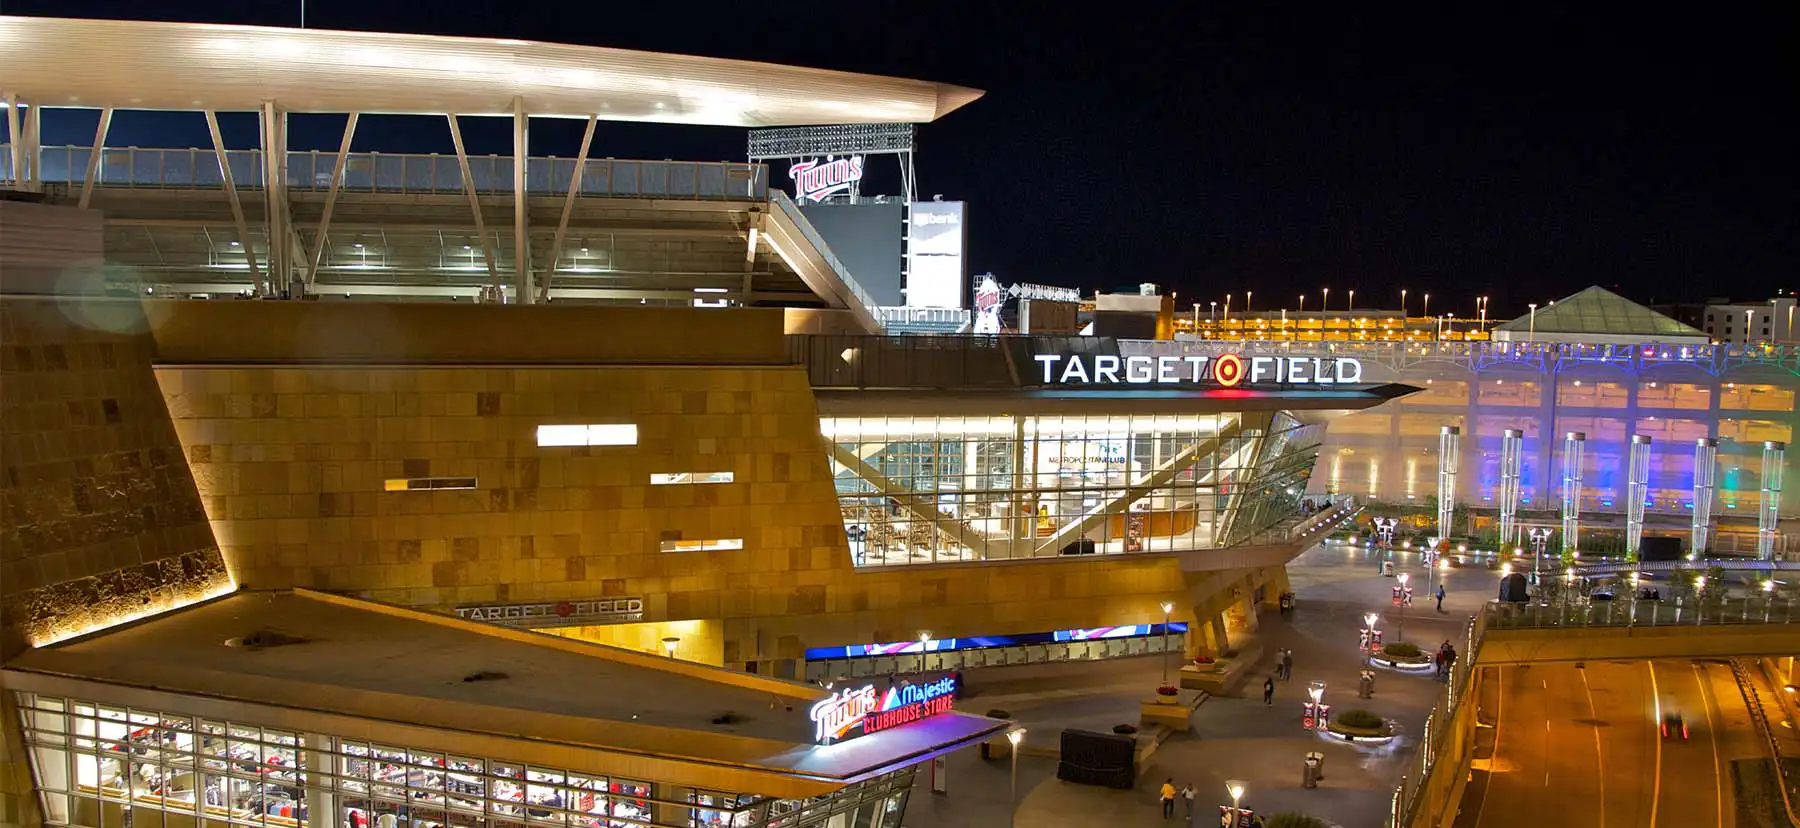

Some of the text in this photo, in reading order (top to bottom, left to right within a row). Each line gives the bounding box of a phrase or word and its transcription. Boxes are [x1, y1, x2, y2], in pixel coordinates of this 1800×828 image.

[789, 155, 862, 201] Twins
[1034, 355, 1361, 383] TARGET FIELD
[1048, 456, 1104, 464] MEROPOITAN
[455, 604, 552, 621] TARGET
[576, 599, 643, 616] FIELD
[902, 676, 956, 704] Majestic
[810, 684, 877, 742] Twins
[863, 694, 953, 734] CLUBHOUSE STORE
